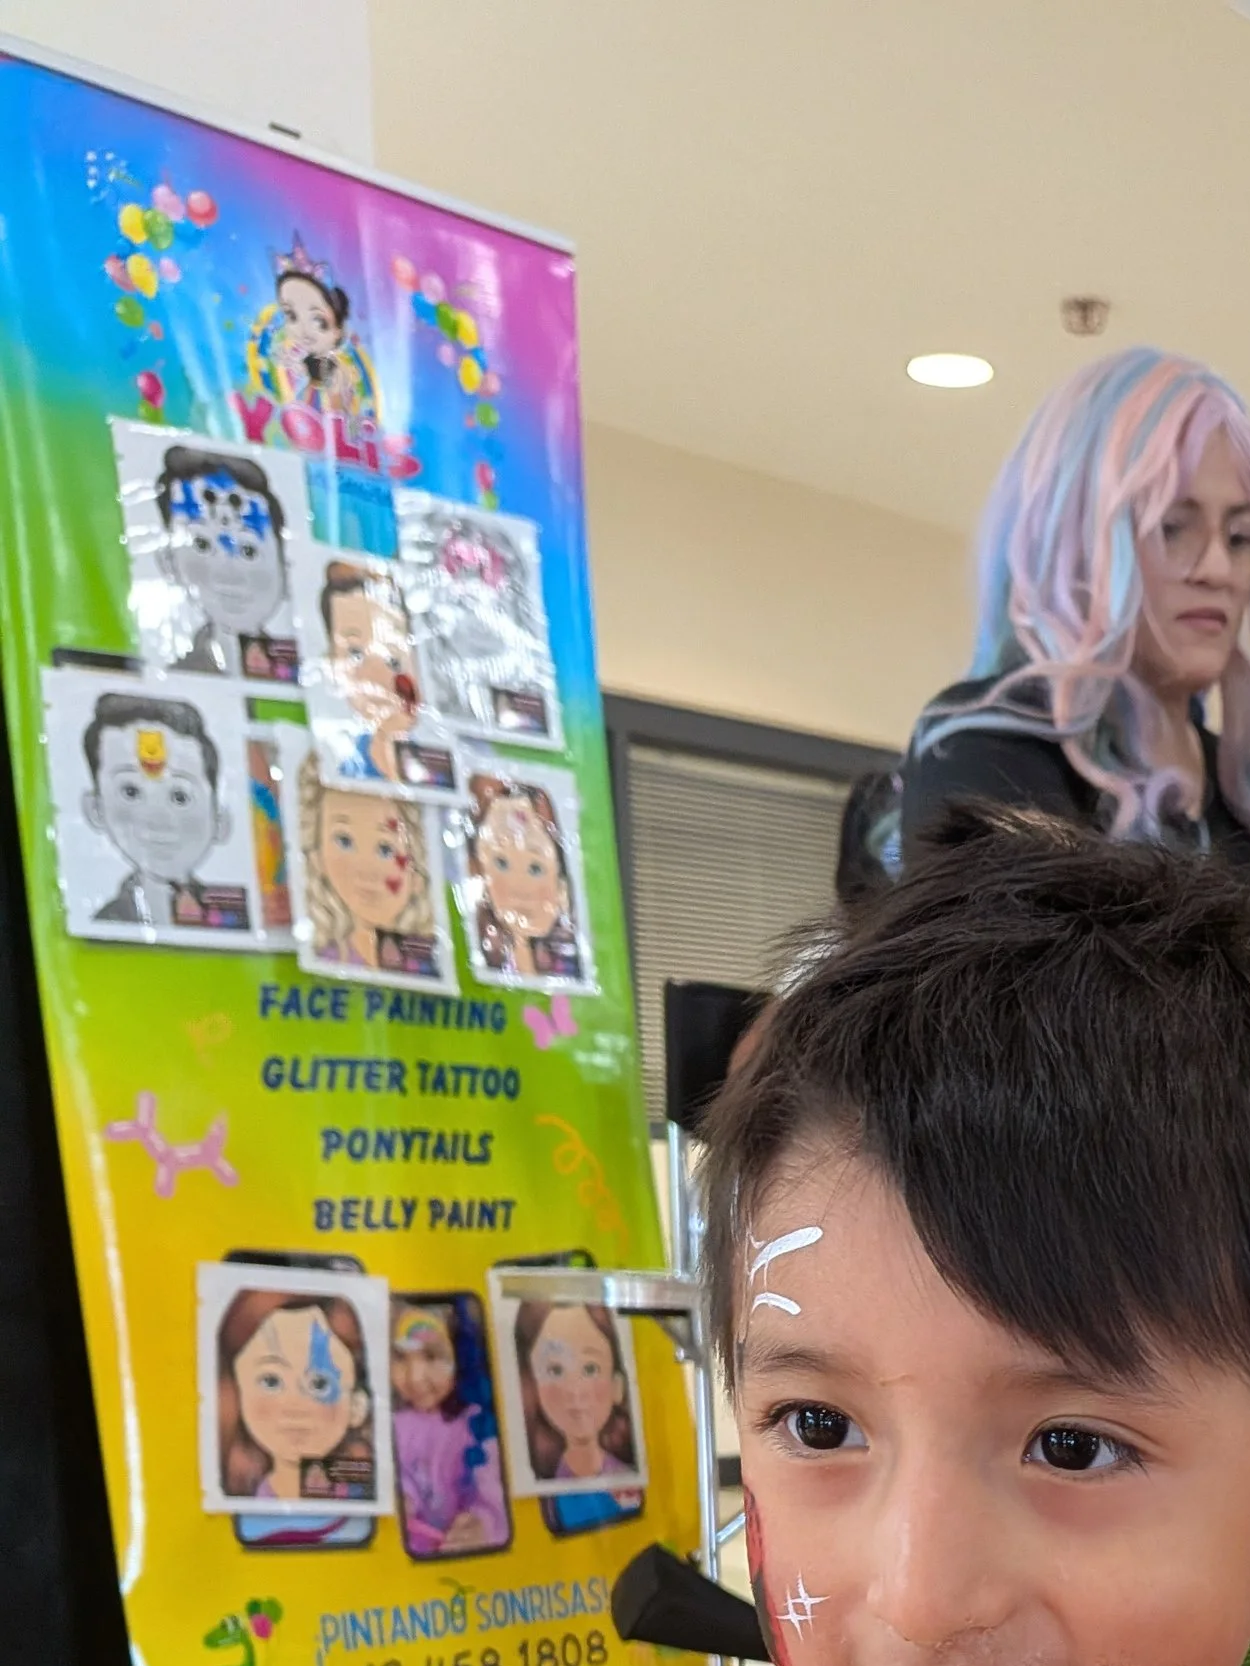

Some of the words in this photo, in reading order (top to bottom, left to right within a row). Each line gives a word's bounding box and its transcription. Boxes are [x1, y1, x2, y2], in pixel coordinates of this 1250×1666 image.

[259, 984, 349, 1021] FACE
[364, 987, 507, 1034] PAINTING
[261, 1056, 408, 1097] GLITTER
[416, 1060, 521, 1101] TATTOO
[320, 1128, 493, 1165] PONYTAILS
[313, 1198, 417, 1231] BELLY
[428, 1198, 517, 1231] PAINT
